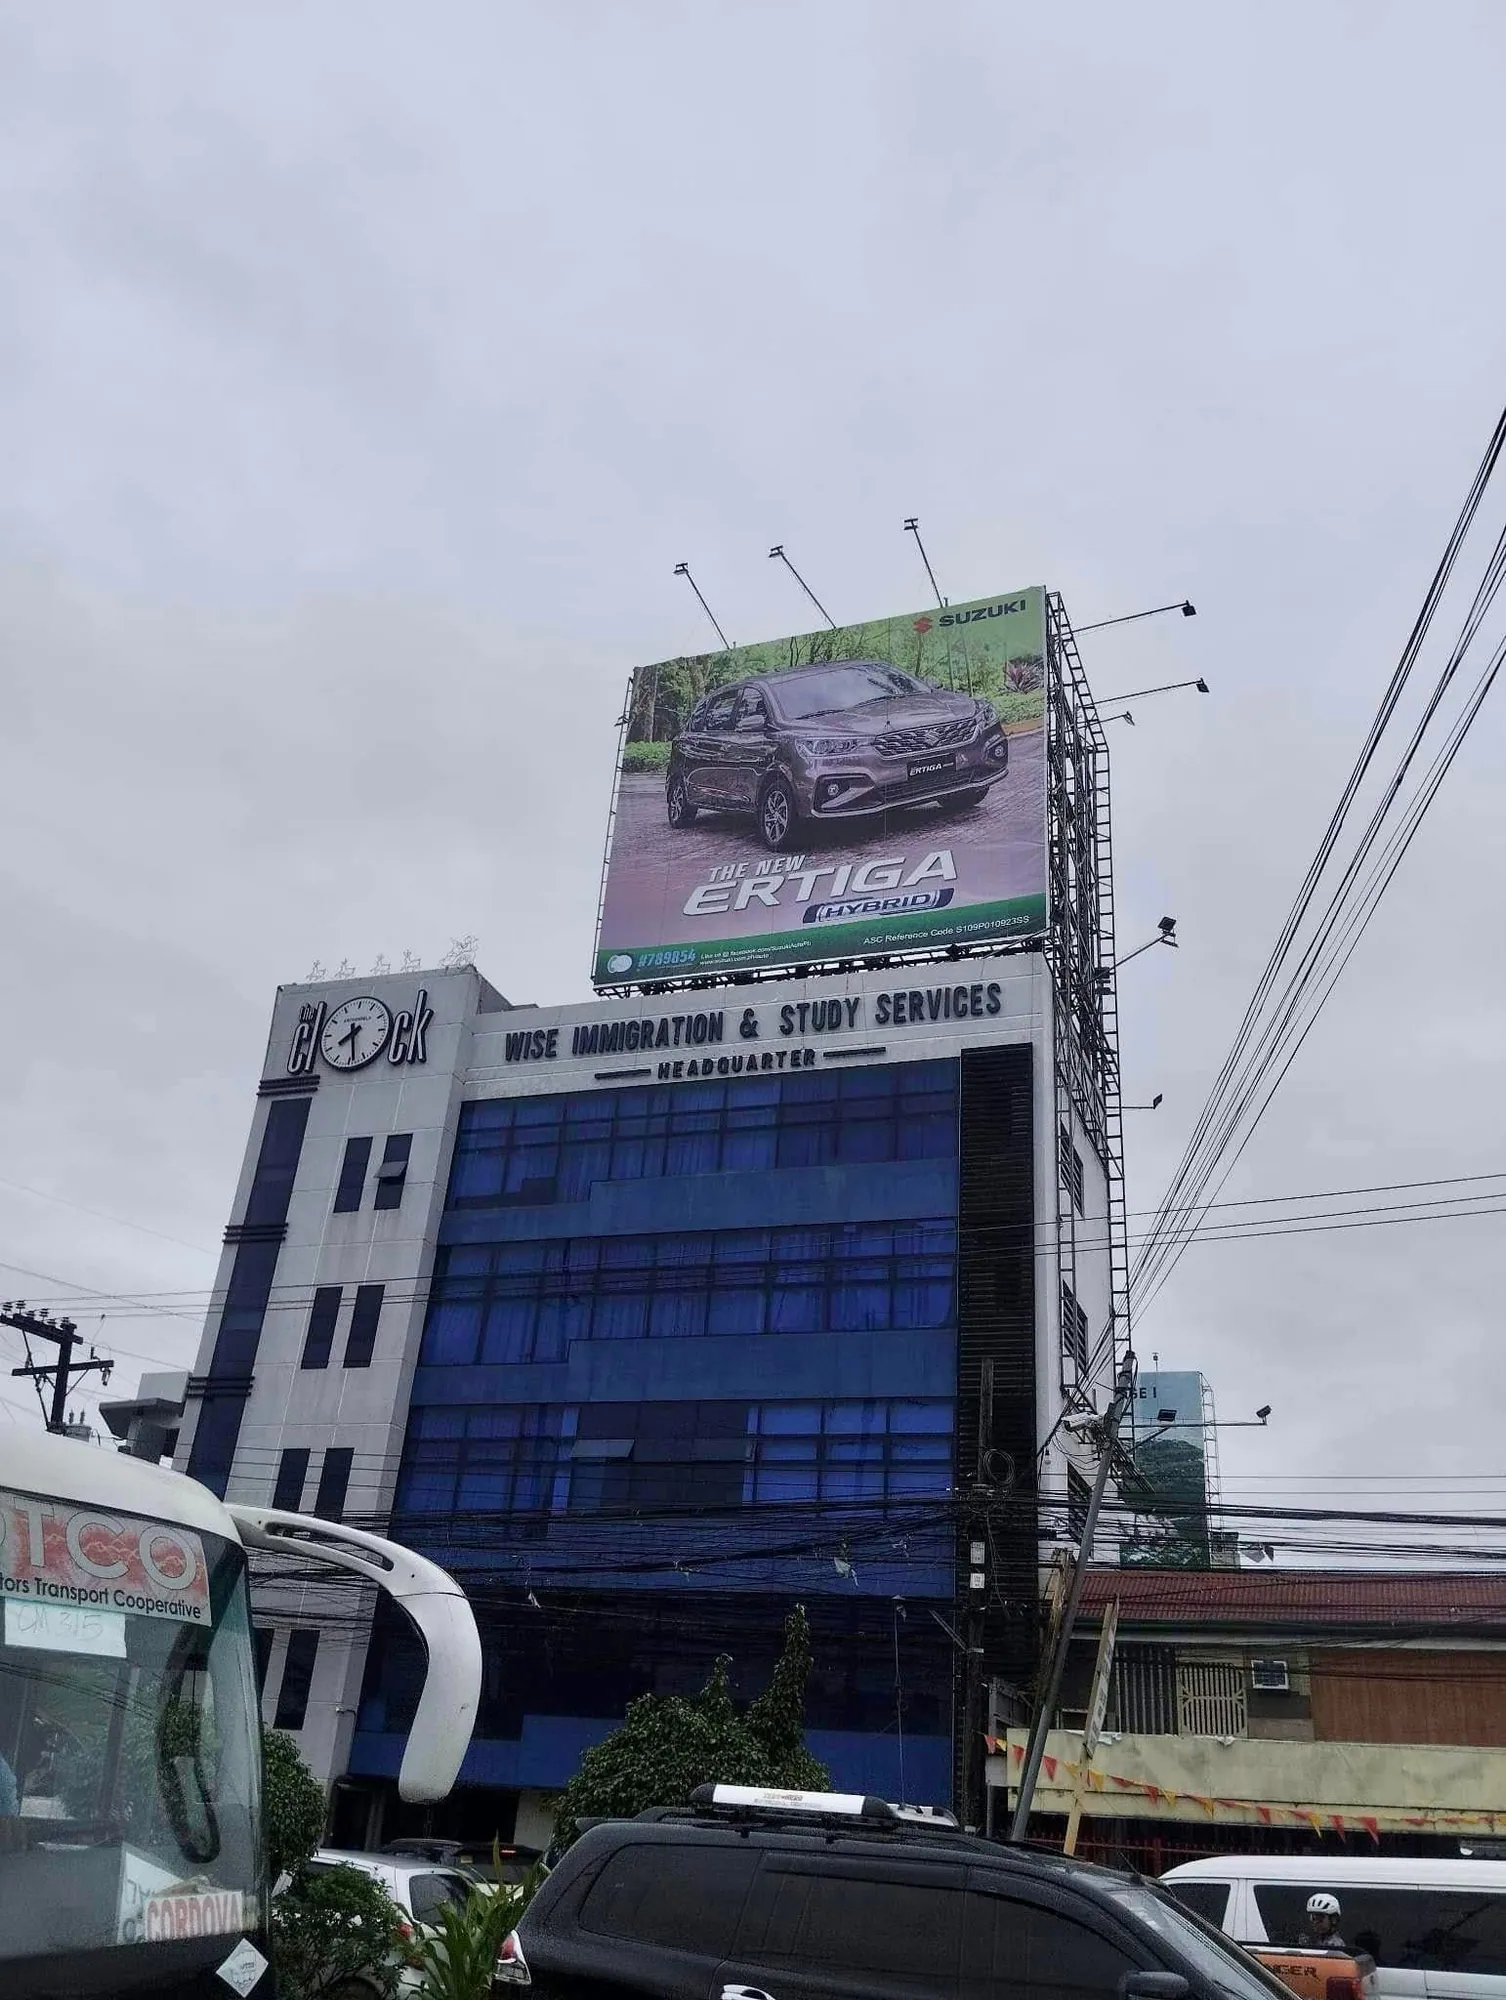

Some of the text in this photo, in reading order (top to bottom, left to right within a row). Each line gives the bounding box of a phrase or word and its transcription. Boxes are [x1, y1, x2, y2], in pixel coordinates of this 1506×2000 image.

[939, 599, 1026, 627] SUZUKI
[909, 763, 943, 776] ERTIGA
[682, 850, 958, 916] ERTIGA
[709, 854, 807, 883] THE NEW
[825, 893, 932, 919] HYBRID
[863, 936, 883, 945] ASC
[885, 931, 928, 943] Reference
[930, 926, 953, 937] Code
[505, 982, 1002, 1061] WISE IMMIGRATION & STUDY SERVICES
[657, 1048, 816, 1080] HEADQUARTER
[0, 1494, 197, 1590] TCO
[35, 1577, 110, 1605] Transport
[113, 1589, 202, 1619] Cooperative
[147, 1893, 244, 1942] CORDOVA
